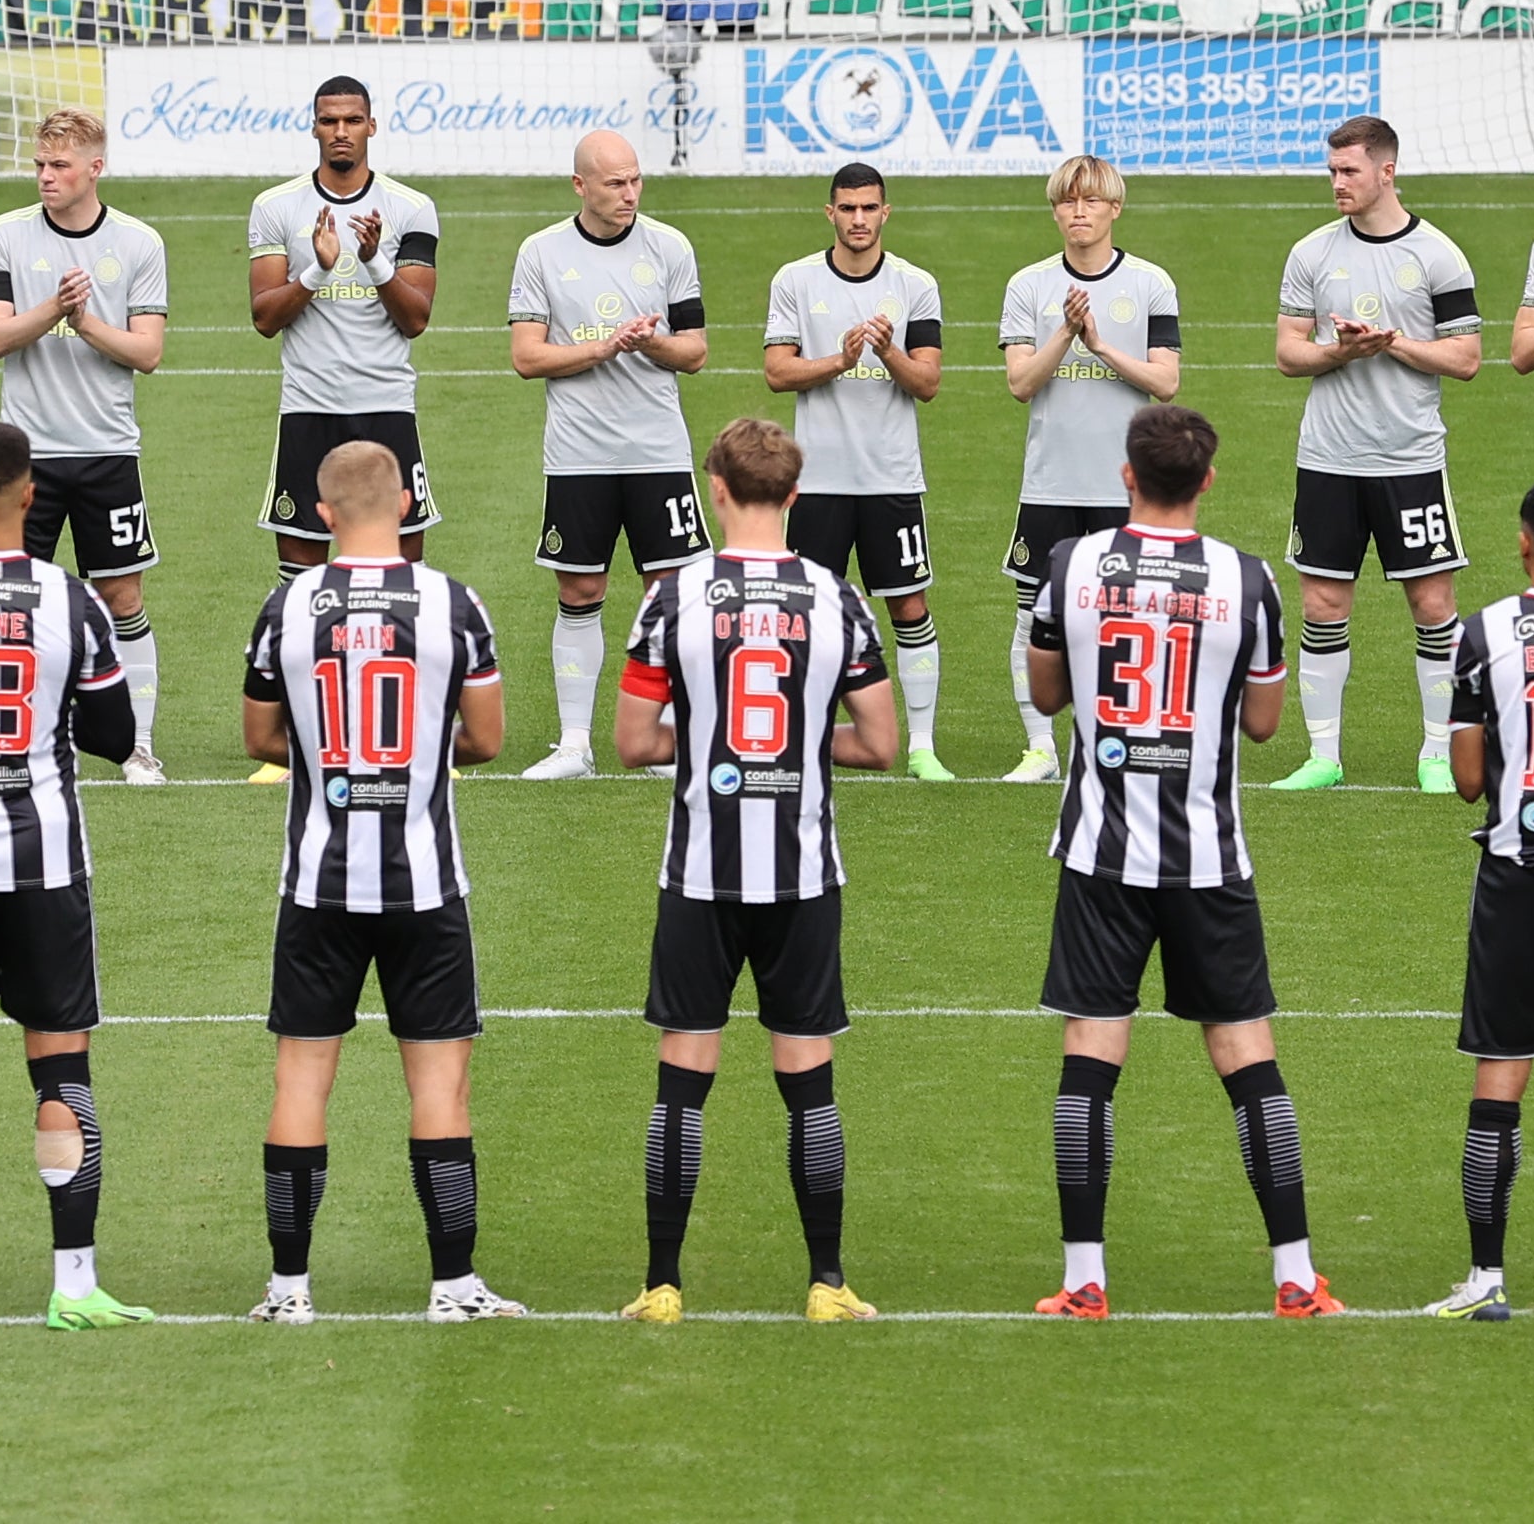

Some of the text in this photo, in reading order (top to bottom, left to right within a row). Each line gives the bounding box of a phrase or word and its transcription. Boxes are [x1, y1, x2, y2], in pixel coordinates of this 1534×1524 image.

[744, 46, 1064, 153] KOVA
[1096, 73, 1368, 107] 0333 355 5225
[122, 79, 315, 143] Kitchens
[390, 80, 632, 135] Bathrooms
[411, 461, 425, 502] 6
[109, 500, 145, 547] 57
[665, 494, 698, 537] 13
[1399, 503, 1446, 549] 56
[897, 524, 926, 567] 11
[1136, 567, 1180, 578] LEASING
[1137, 558, 1208, 574] FIRST VEHICLE
[1, 583, 40, 594] VEHICLE
[348, 591, 419, 603] FIRST VEHICLE
[744, 581, 814, 596] FIRST VEHICLE
[744, 590, 787, 601] LEASING
[1077, 585, 1230, 623] GALLAGHER
[348, 600, 391, 610] LEASING
[331, 624, 395, 651] MAIN
[715, 612, 806, 641] O'HARA
[1095, 617, 1195, 731] 31
[313, 658, 419, 768] 10
[727, 645, 791, 756] 6
[1129, 744, 1189, 757] consilium
[351, 781, 406, 793] consilium
[744, 769, 801, 781] consilium
